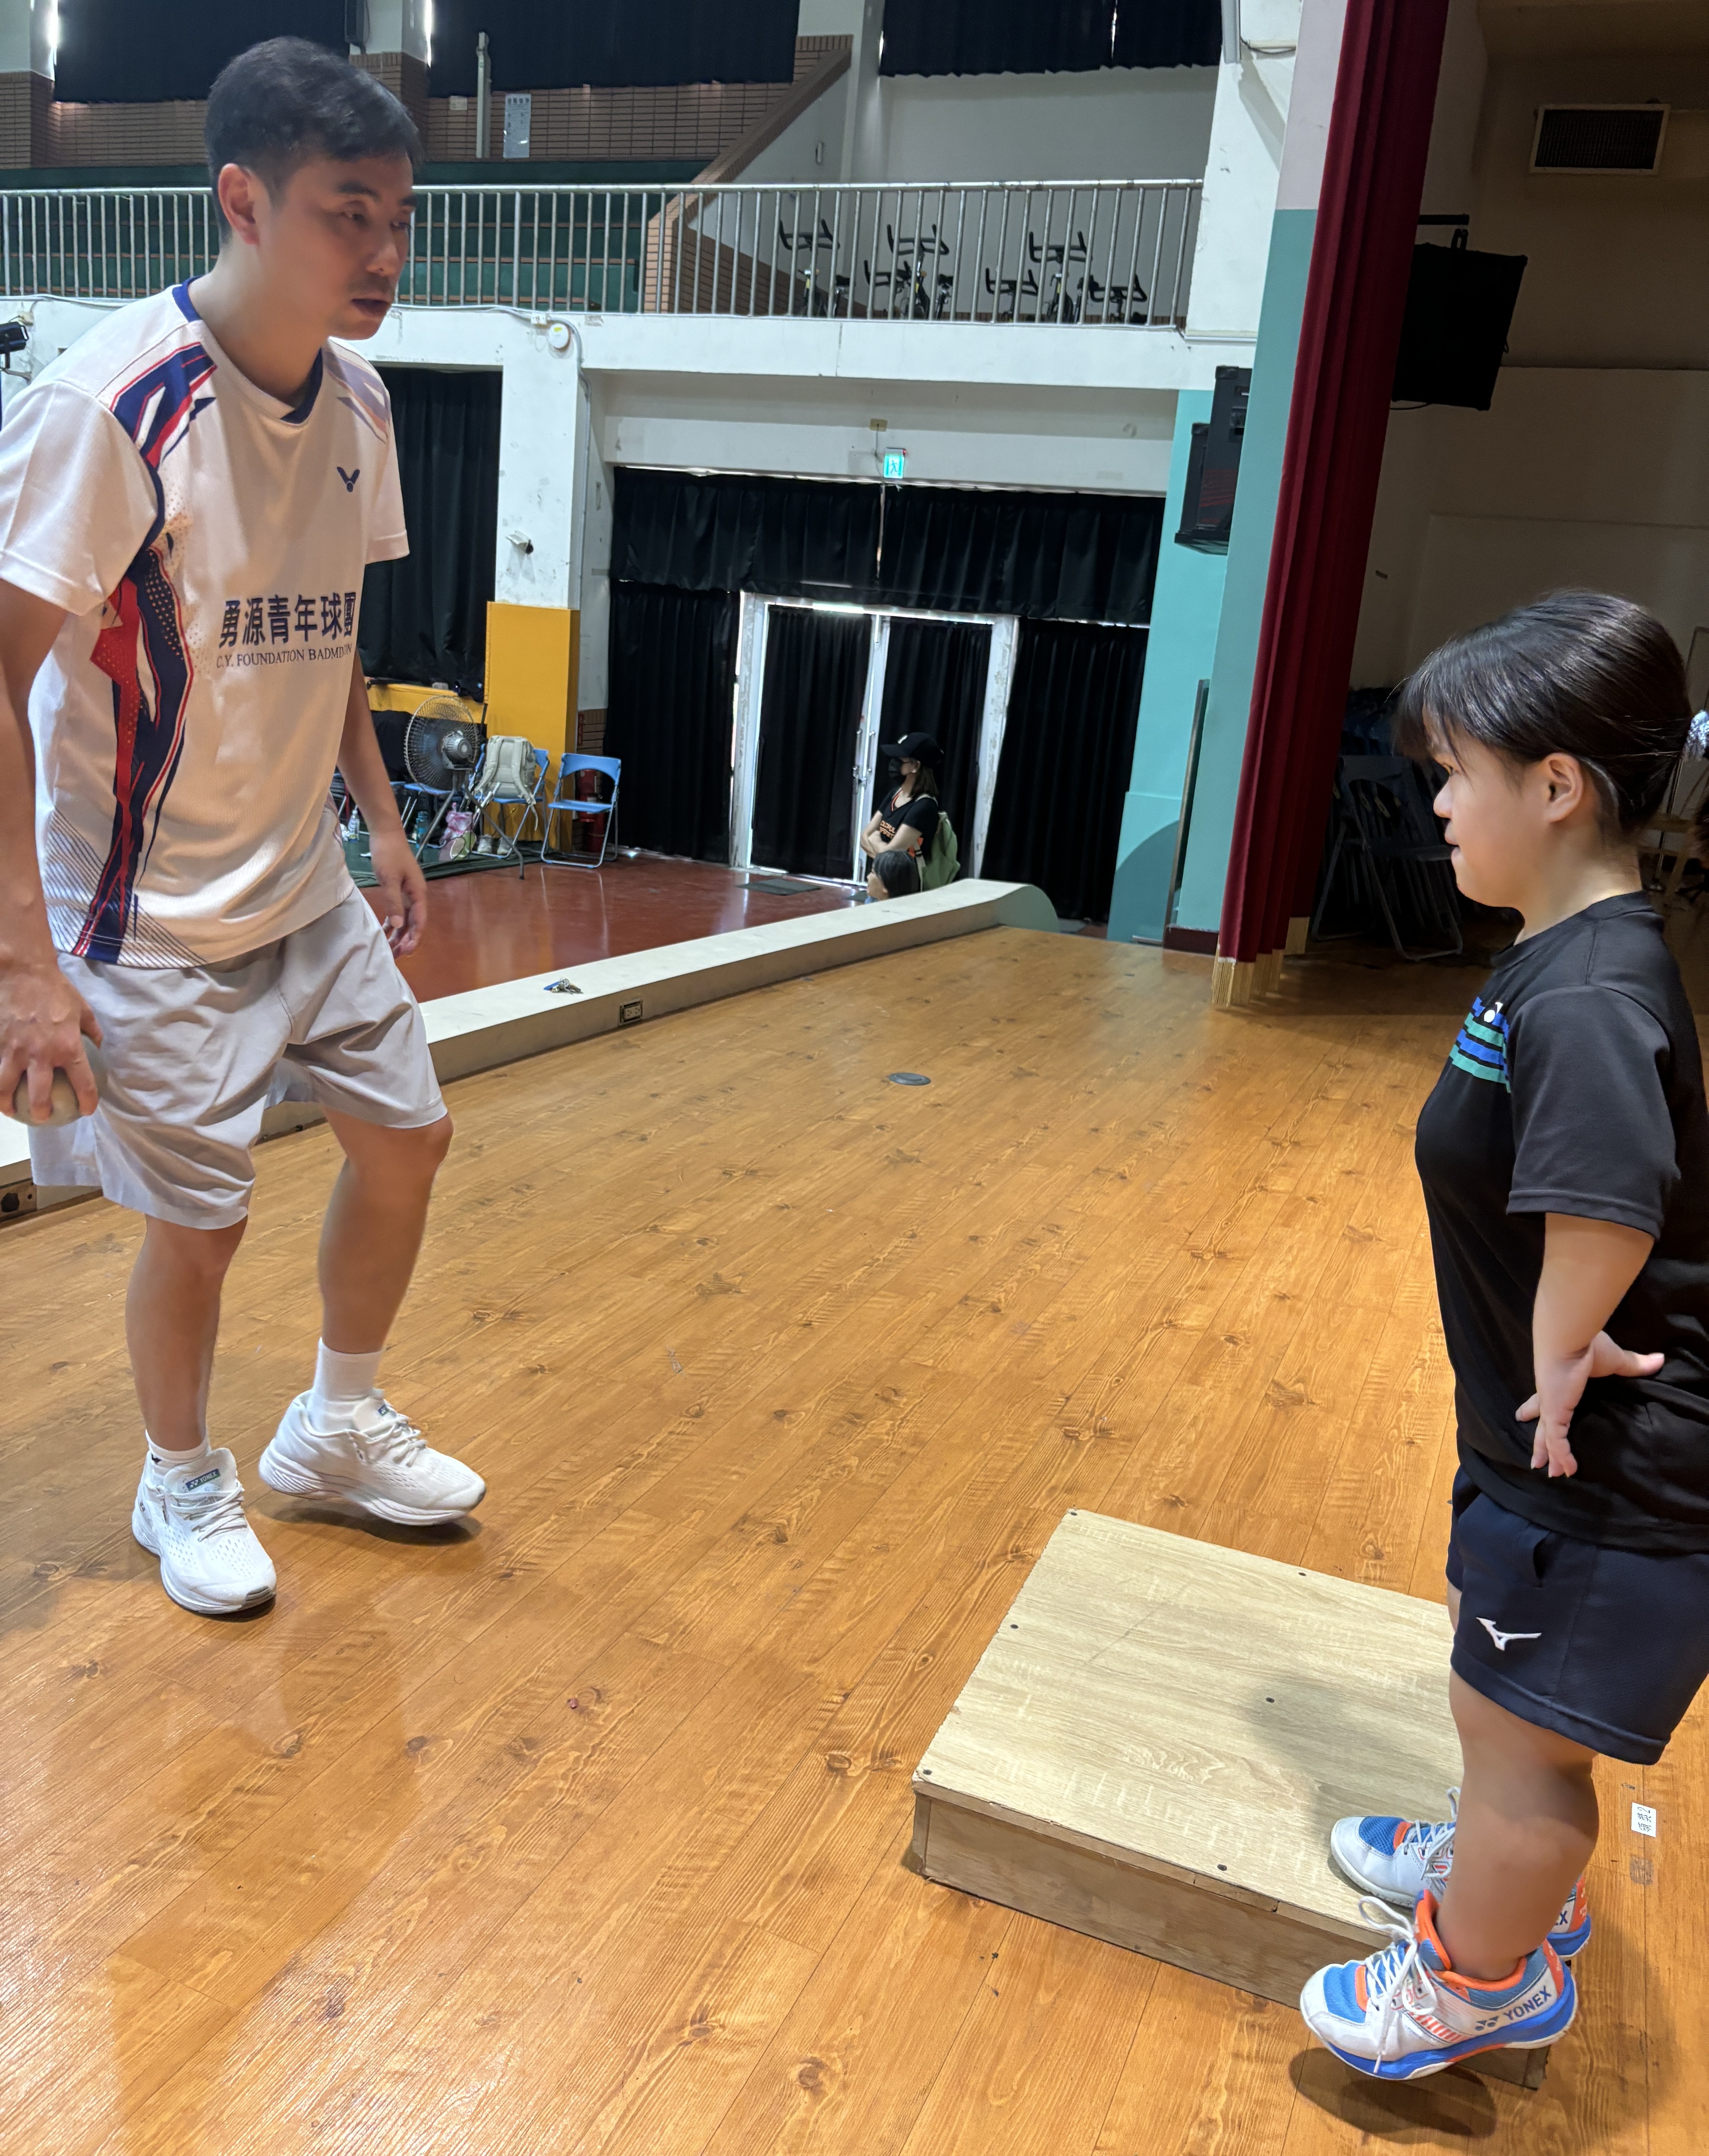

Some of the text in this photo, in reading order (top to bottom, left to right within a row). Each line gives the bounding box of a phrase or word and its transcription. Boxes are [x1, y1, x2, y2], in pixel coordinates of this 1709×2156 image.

[219, 592, 356, 649] 勇源青年球團
[217, 654, 233, 669] C.Y.
[237, 649, 304, 667] FOUNDATION
[199, 1471, 217, 1483] YONEX
[1503, 1985, 1552, 2021] YONEX
